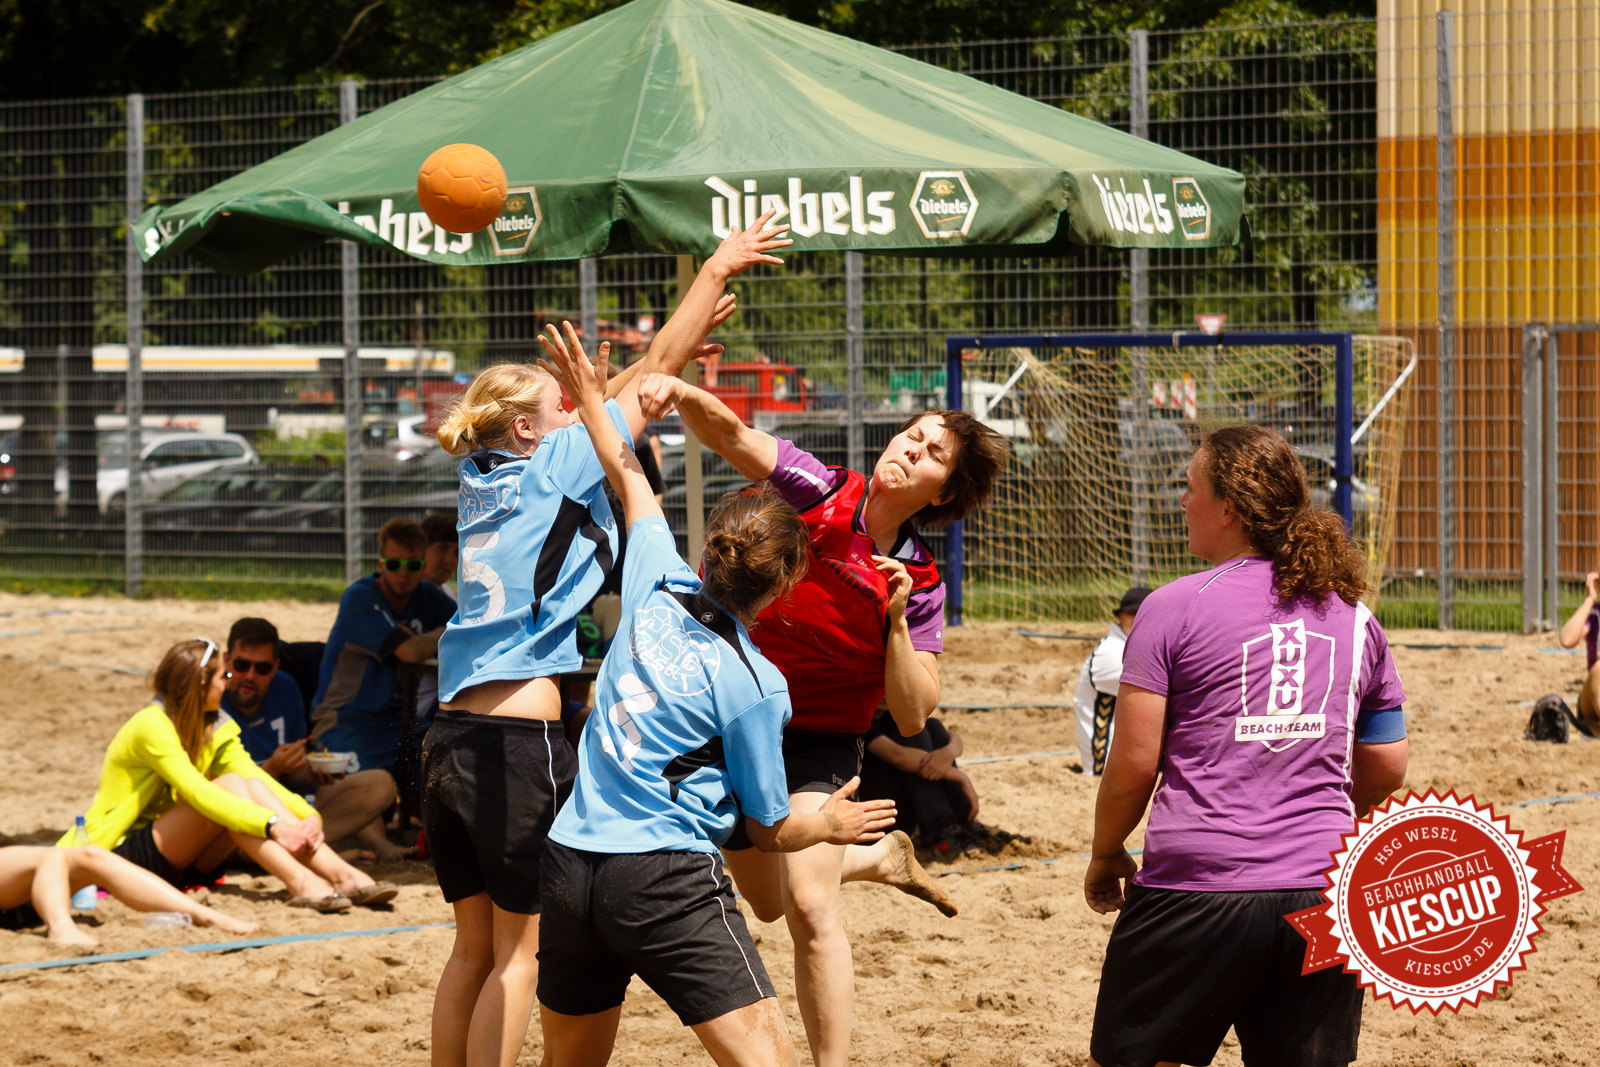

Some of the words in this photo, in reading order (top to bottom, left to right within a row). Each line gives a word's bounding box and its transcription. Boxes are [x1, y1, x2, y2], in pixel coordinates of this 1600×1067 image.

[494, 214, 534, 233] Diebels
[704, 175, 896, 239] Diebels
[919, 198, 968, 214] Diebels
[461, 531, 506, 625] 5
[1275, 626, 1303, 710] XUXU
